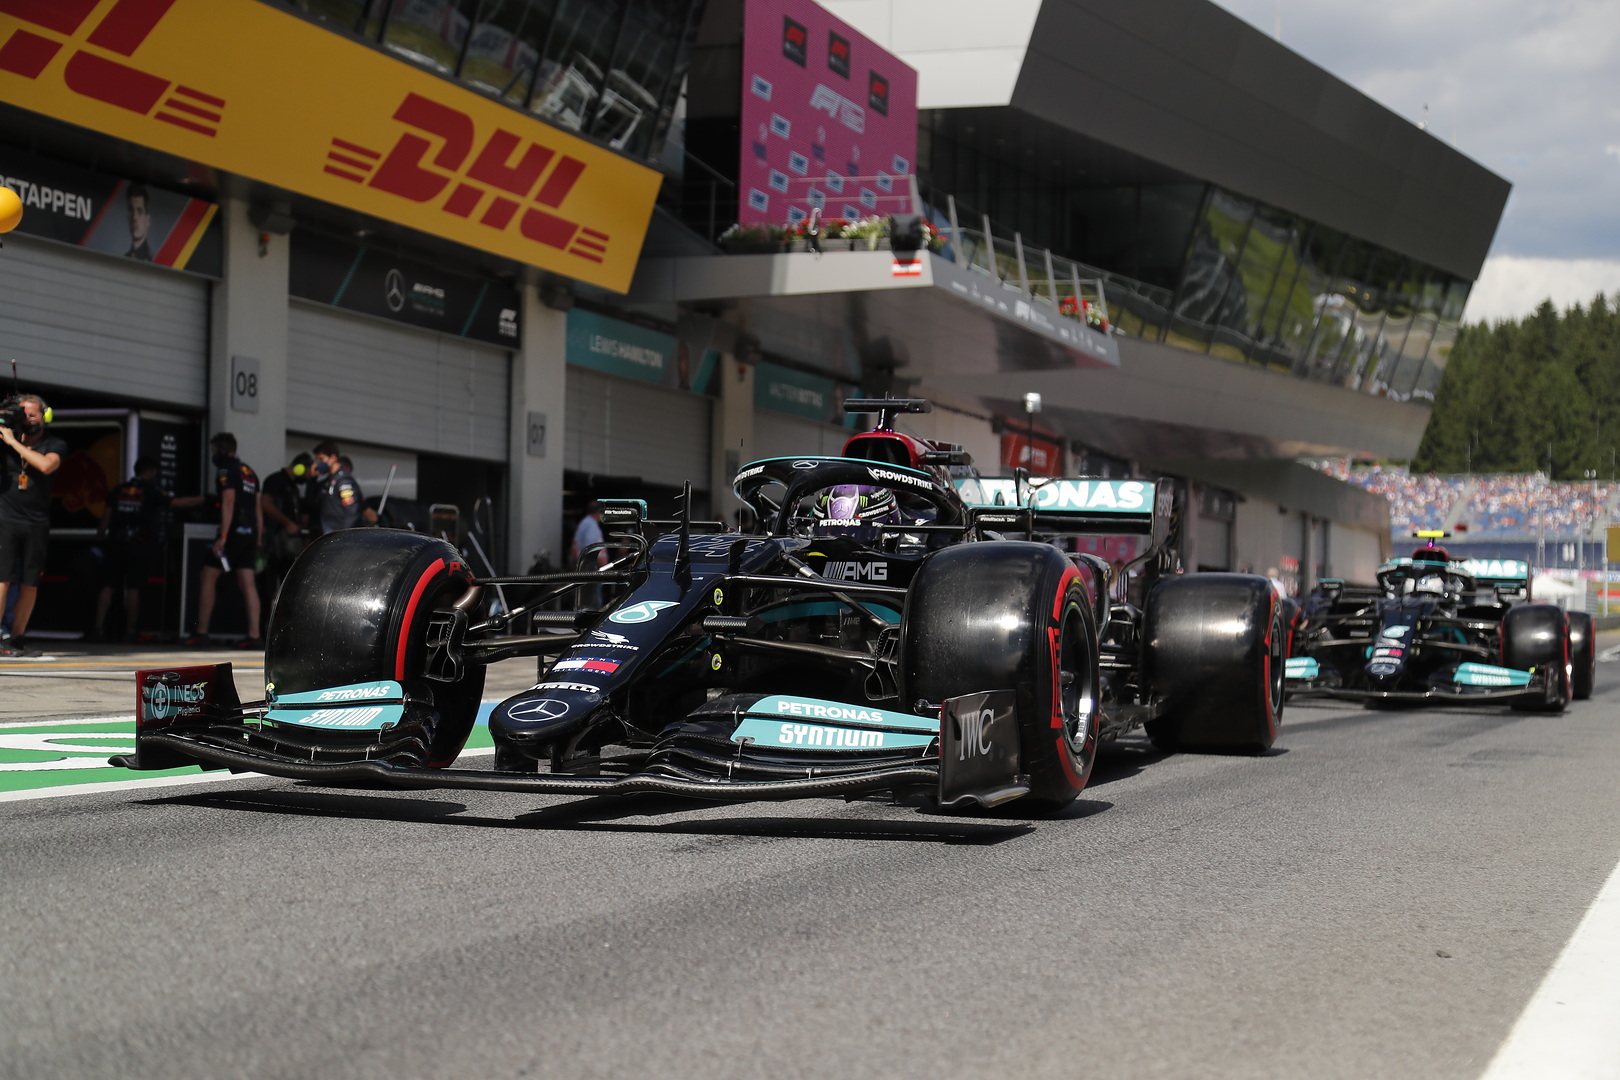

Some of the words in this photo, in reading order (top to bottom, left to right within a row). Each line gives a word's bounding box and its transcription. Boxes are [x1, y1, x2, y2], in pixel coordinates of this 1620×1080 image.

[367, 92, 588, 251] DHL
[0, 175, 92, 221] STAPPEN
[235, 371, 258, 397] 08
[529, 423, 546, 445] 07
[873, 468, 933, 491] CROWDSTRIKE
[819, 518, 861, 527] PETRONAS
[841, 561, 888, 581] AMG
[571, 642, 640, 651] CROWDSTRIKE
[555, 667, 607, 675] HILFIGER
[174, 684, 205, 702] INEOS
[317, 686, 390, 701] PETRONAS
[531, 682, 600, 694] PIRELLI
[177, 706, 201, 716] Hygienics
[299, 707, 383, 726] SYNTIUM
[777, 701, 883, 722] PETRONAS
[779, 724, 884, 747] SYNTIUM
[959, 708, 994, 761] IWC
